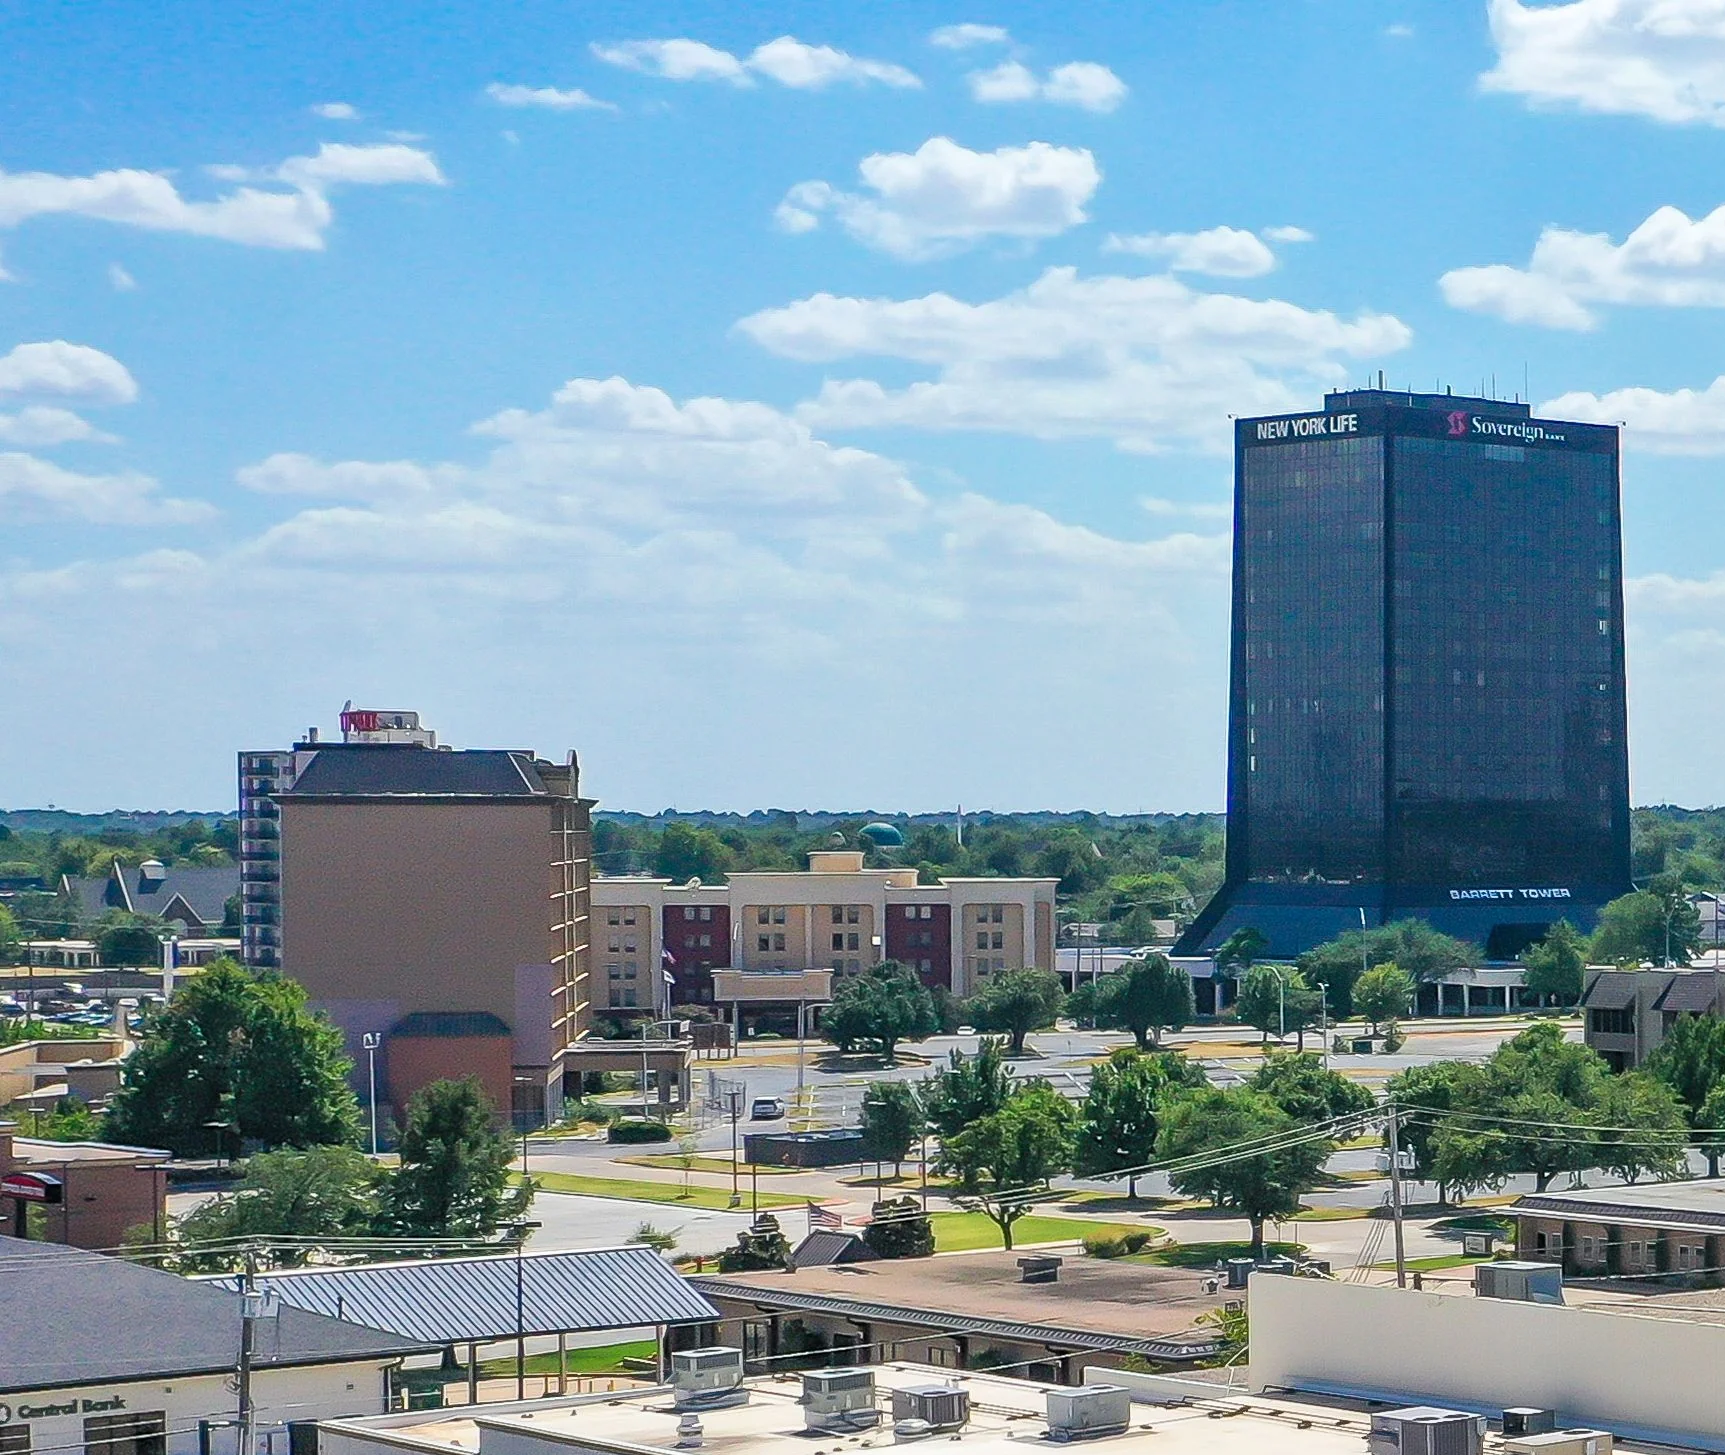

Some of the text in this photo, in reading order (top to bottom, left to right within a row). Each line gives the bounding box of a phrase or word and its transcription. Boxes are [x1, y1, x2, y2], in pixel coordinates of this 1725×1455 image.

[1257, 413, 1358, 440] NEW YORK LIFE
[1471, 415, 1544, 444] Sovereign
[1449, 888, 1571, 899] BARRETT TOWER
[82, 1395, 126, 1413] Bank
